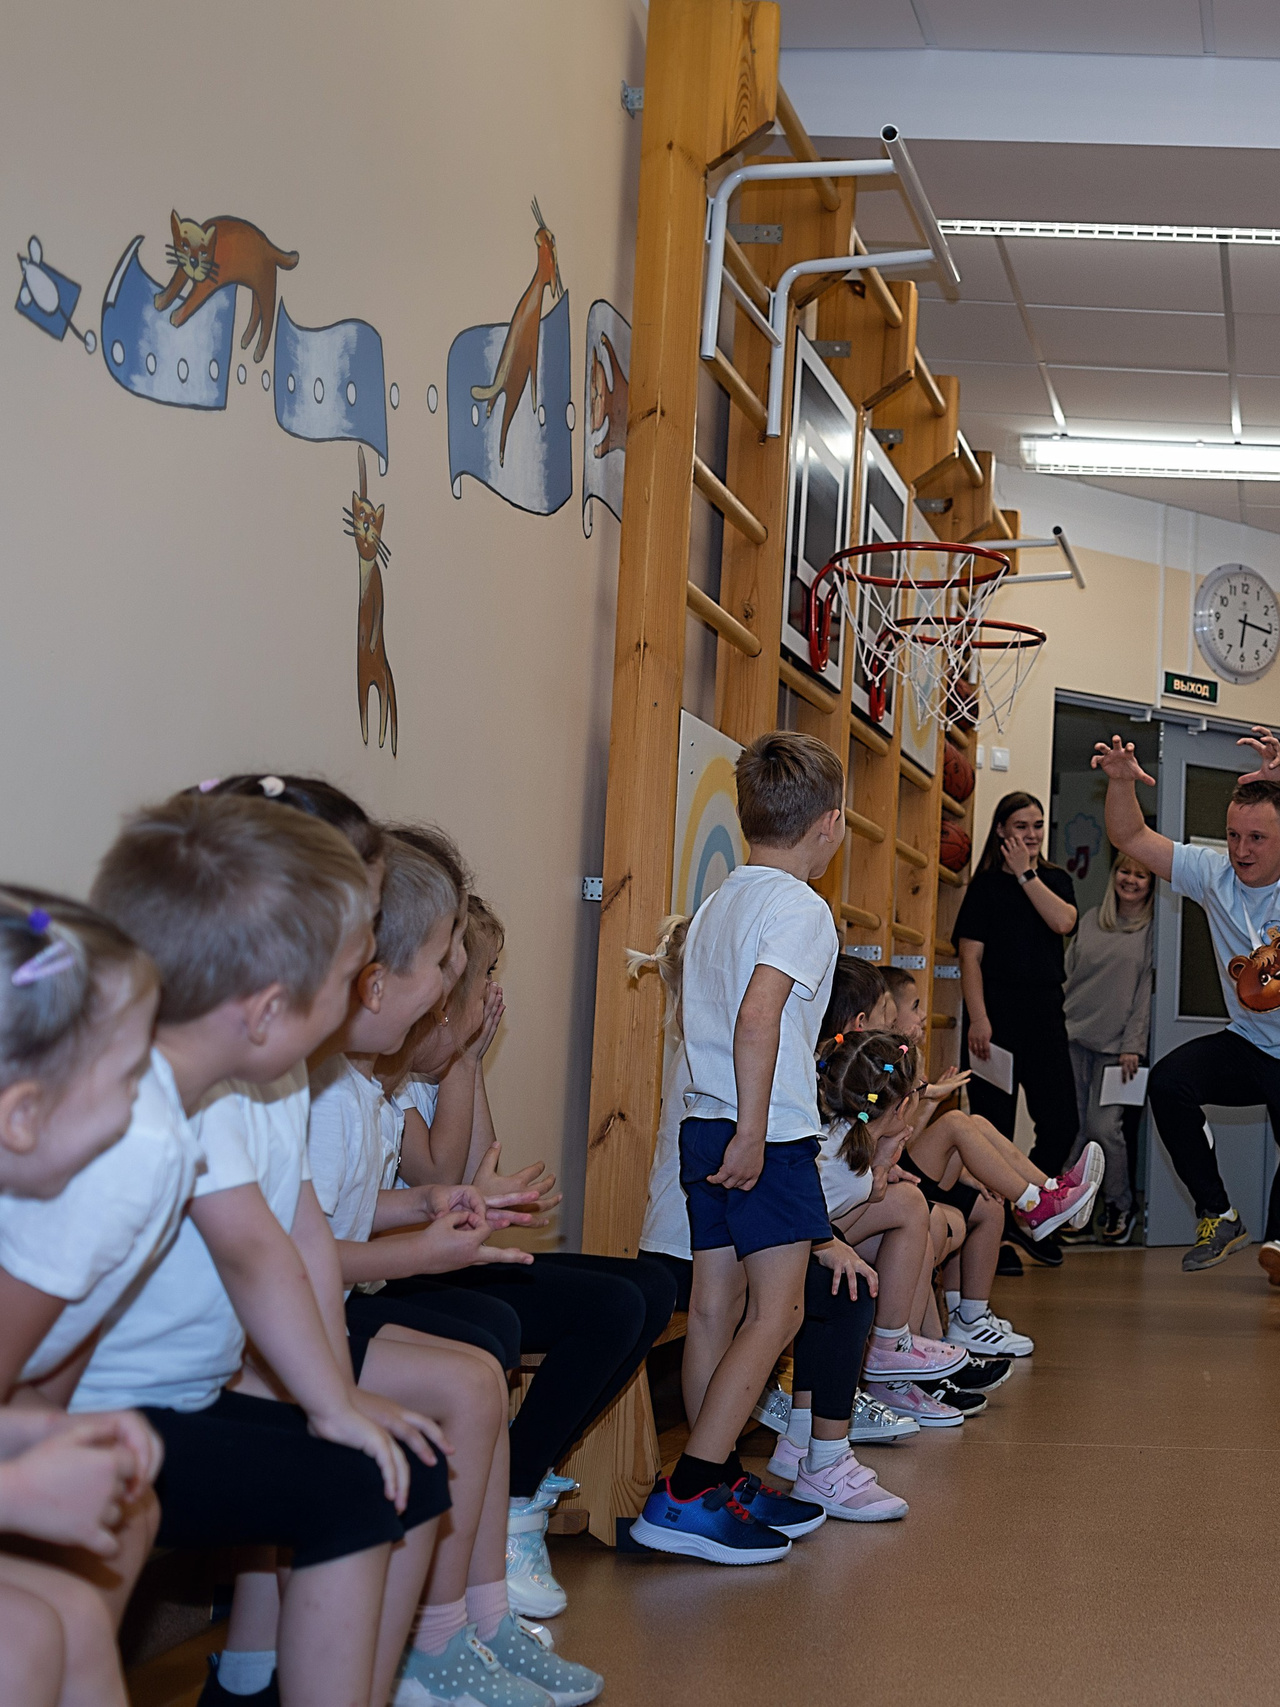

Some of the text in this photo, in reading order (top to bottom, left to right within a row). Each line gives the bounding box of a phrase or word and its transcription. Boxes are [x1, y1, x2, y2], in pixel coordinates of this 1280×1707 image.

[1228, 585, 1237, 596] 11
[1241, 583, 1250, 595] 12
[1219, 596, 1229, 607] 10
[1263, 605, 1269, 616] 2
[1214, 612, 1221, 622] 9
[1218, 629, 1224, 640] 8
[1226, 644, 1233, 654] 7
[1262, 639, 1268, 648] 4
[1239, 652, 1245, 663] 6
[1254, 650, 1260, 661] 5
[1173, 679, 1209, 698] ВЫХОД
